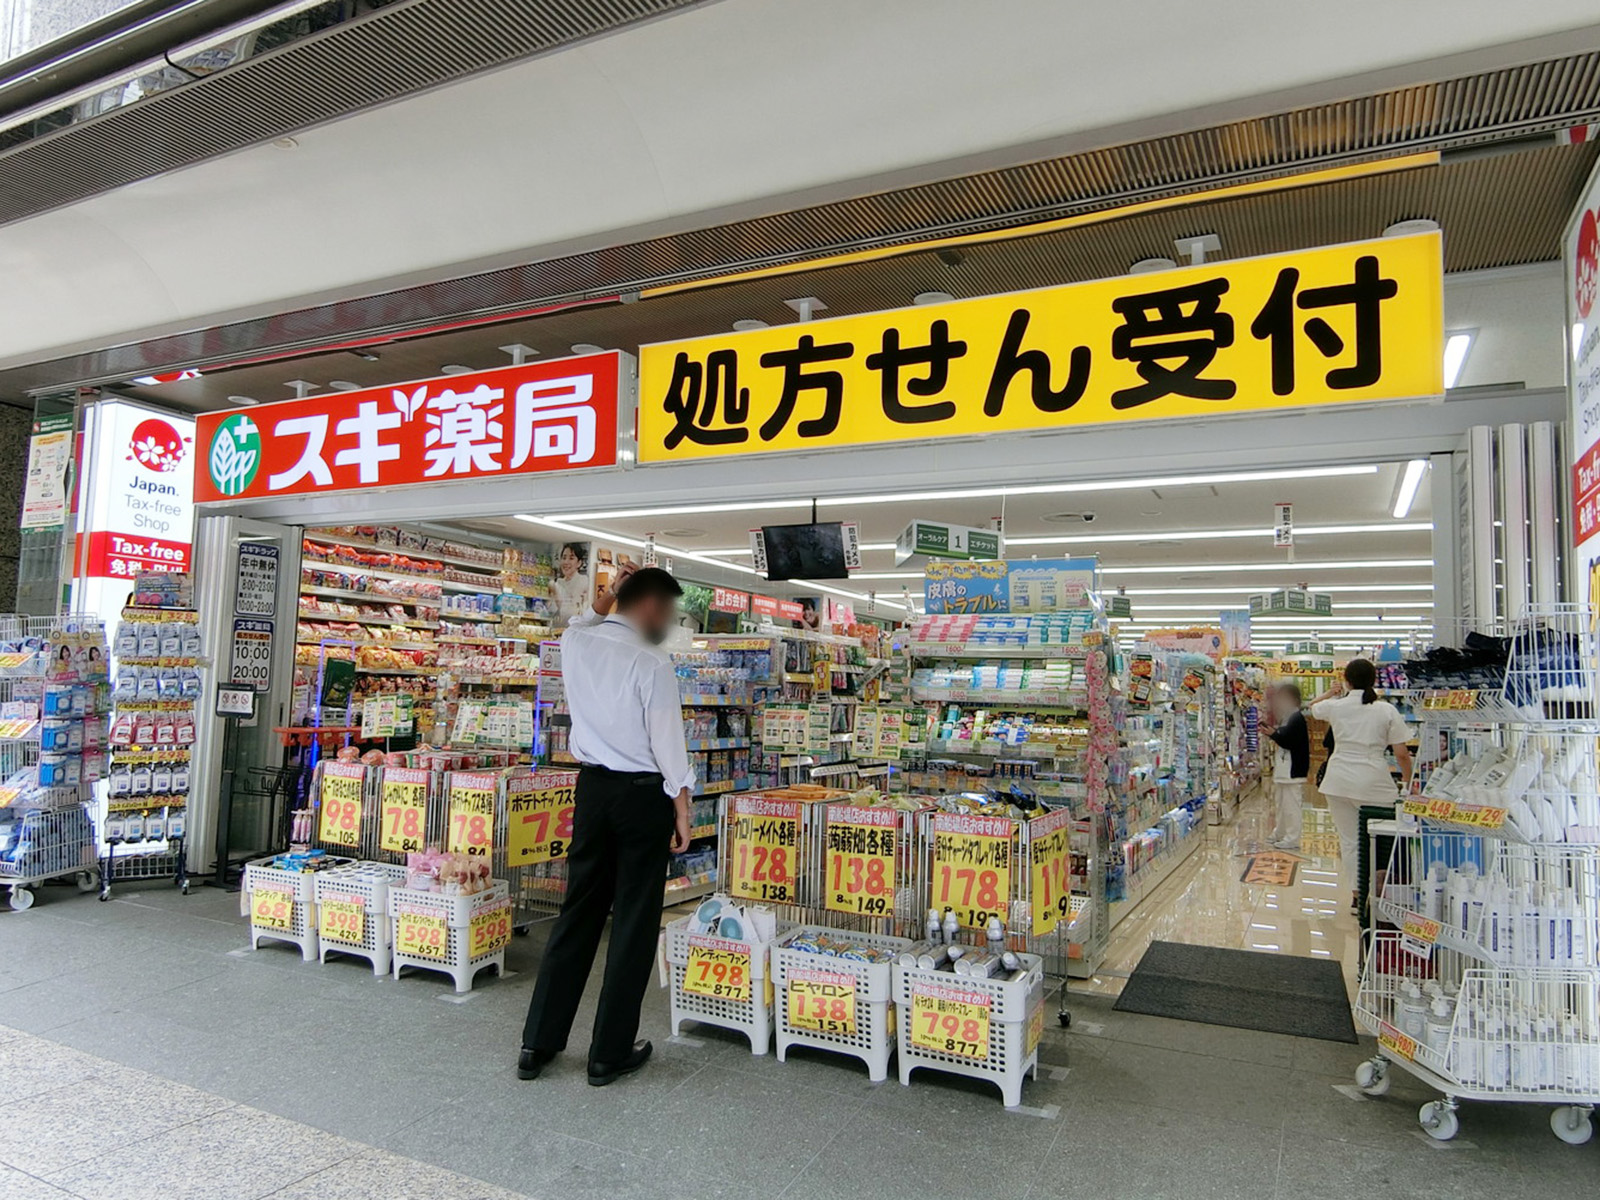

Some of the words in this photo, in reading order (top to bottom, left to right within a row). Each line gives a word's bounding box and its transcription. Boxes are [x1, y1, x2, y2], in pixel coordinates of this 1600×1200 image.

[660, 254, 1400, 452] 処方せん受付
[268, 373, 598, 491] スギ薬局
[124, 494, 182, 517] Tax-free
[133, 513, 170, 532] Shop
[112, 536, 184, 561] Tax-free
[954, 535, 962, 548] 1
[241, 557, 276, 571] 年中無休
[235, 646, 270, 660] 10:00
[233, 665, 268, 679] 20:00
[1429, 800, 1452, 816] 448
[828, 824, 894, 856] 蒟蒻畑各種
[790, 980, 852, 998] ヒヤロン
